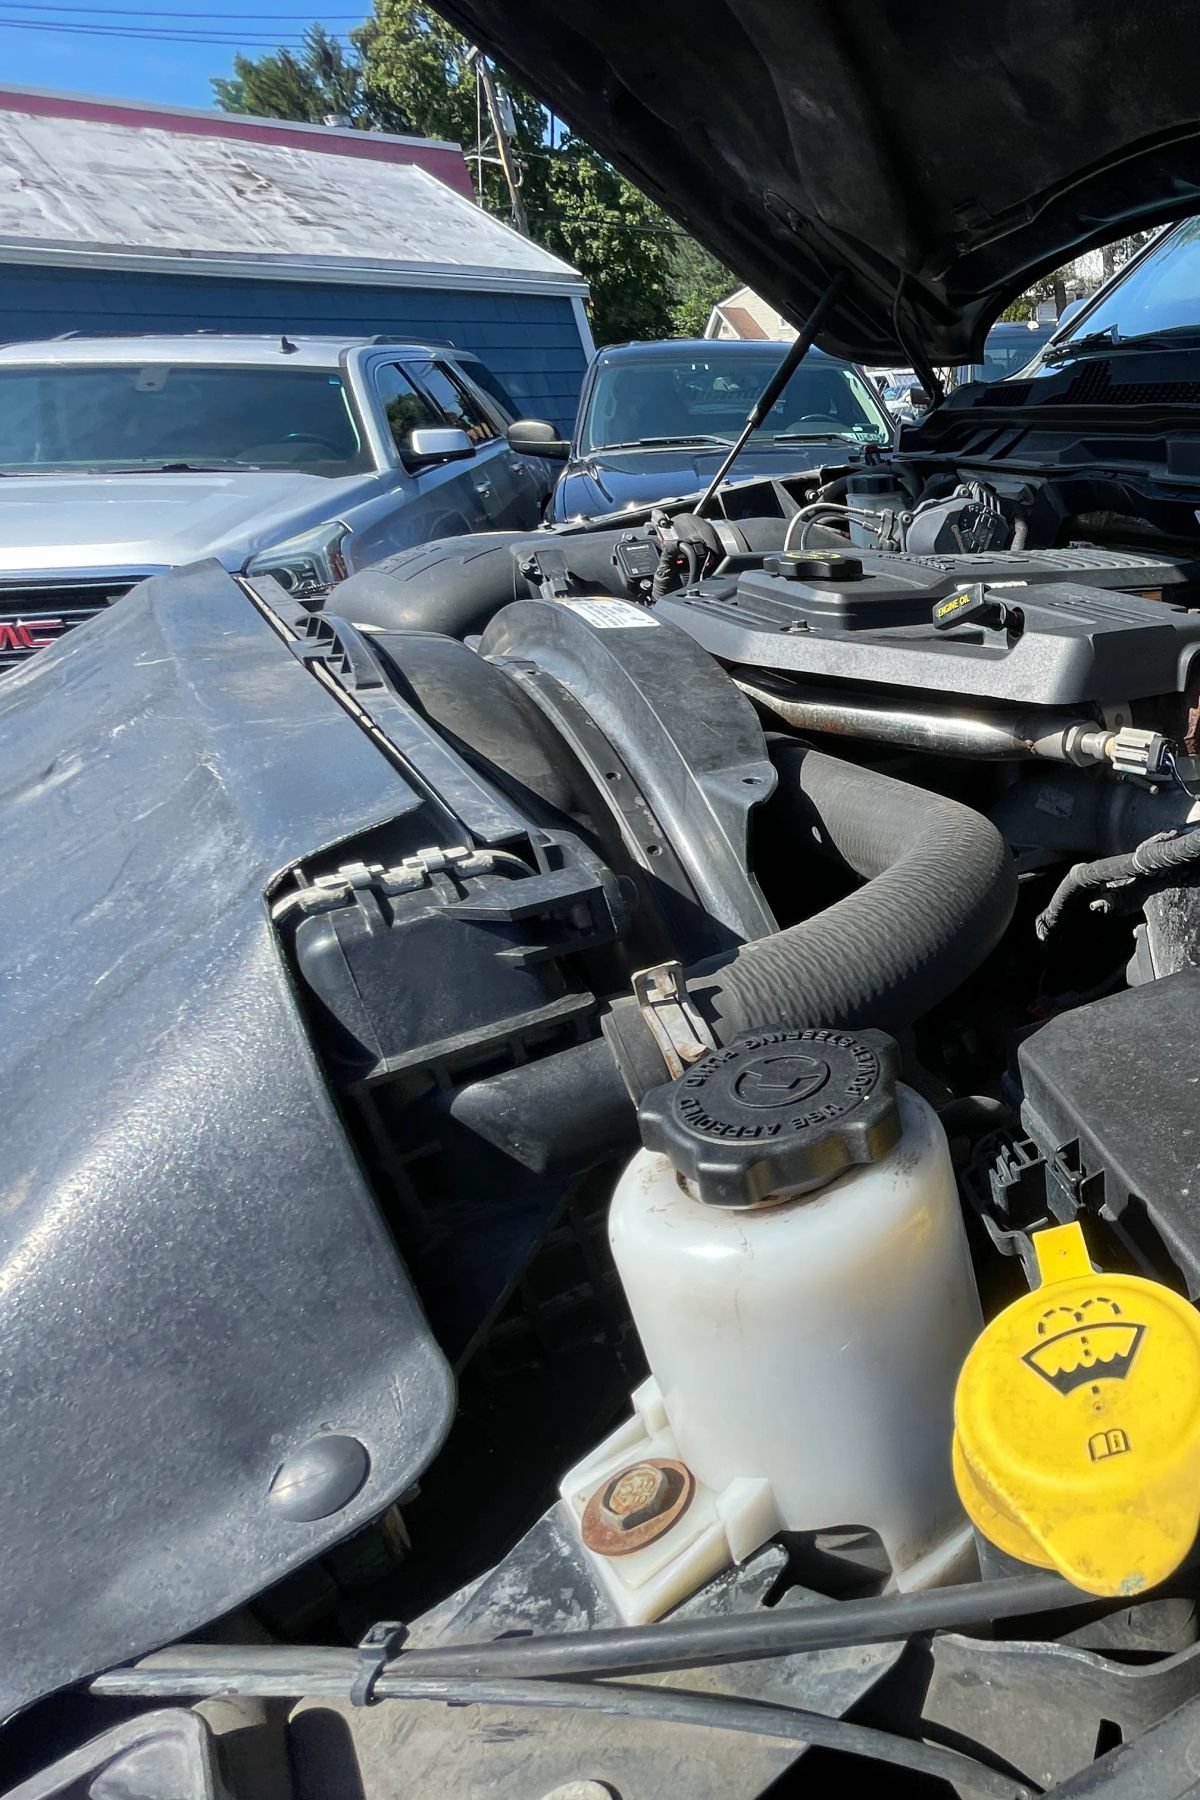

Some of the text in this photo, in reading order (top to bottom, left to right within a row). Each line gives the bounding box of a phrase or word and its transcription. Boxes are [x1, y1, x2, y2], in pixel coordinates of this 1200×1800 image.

[938, 593, 972, 618] ENGINE OIL
[743, 1029, 855, 1051] STEERING
[684, 1048, 739, 1089] FLUID
[844, 1045, 877, 1098] POWER
[791, 1102, 845, 1131] USE
